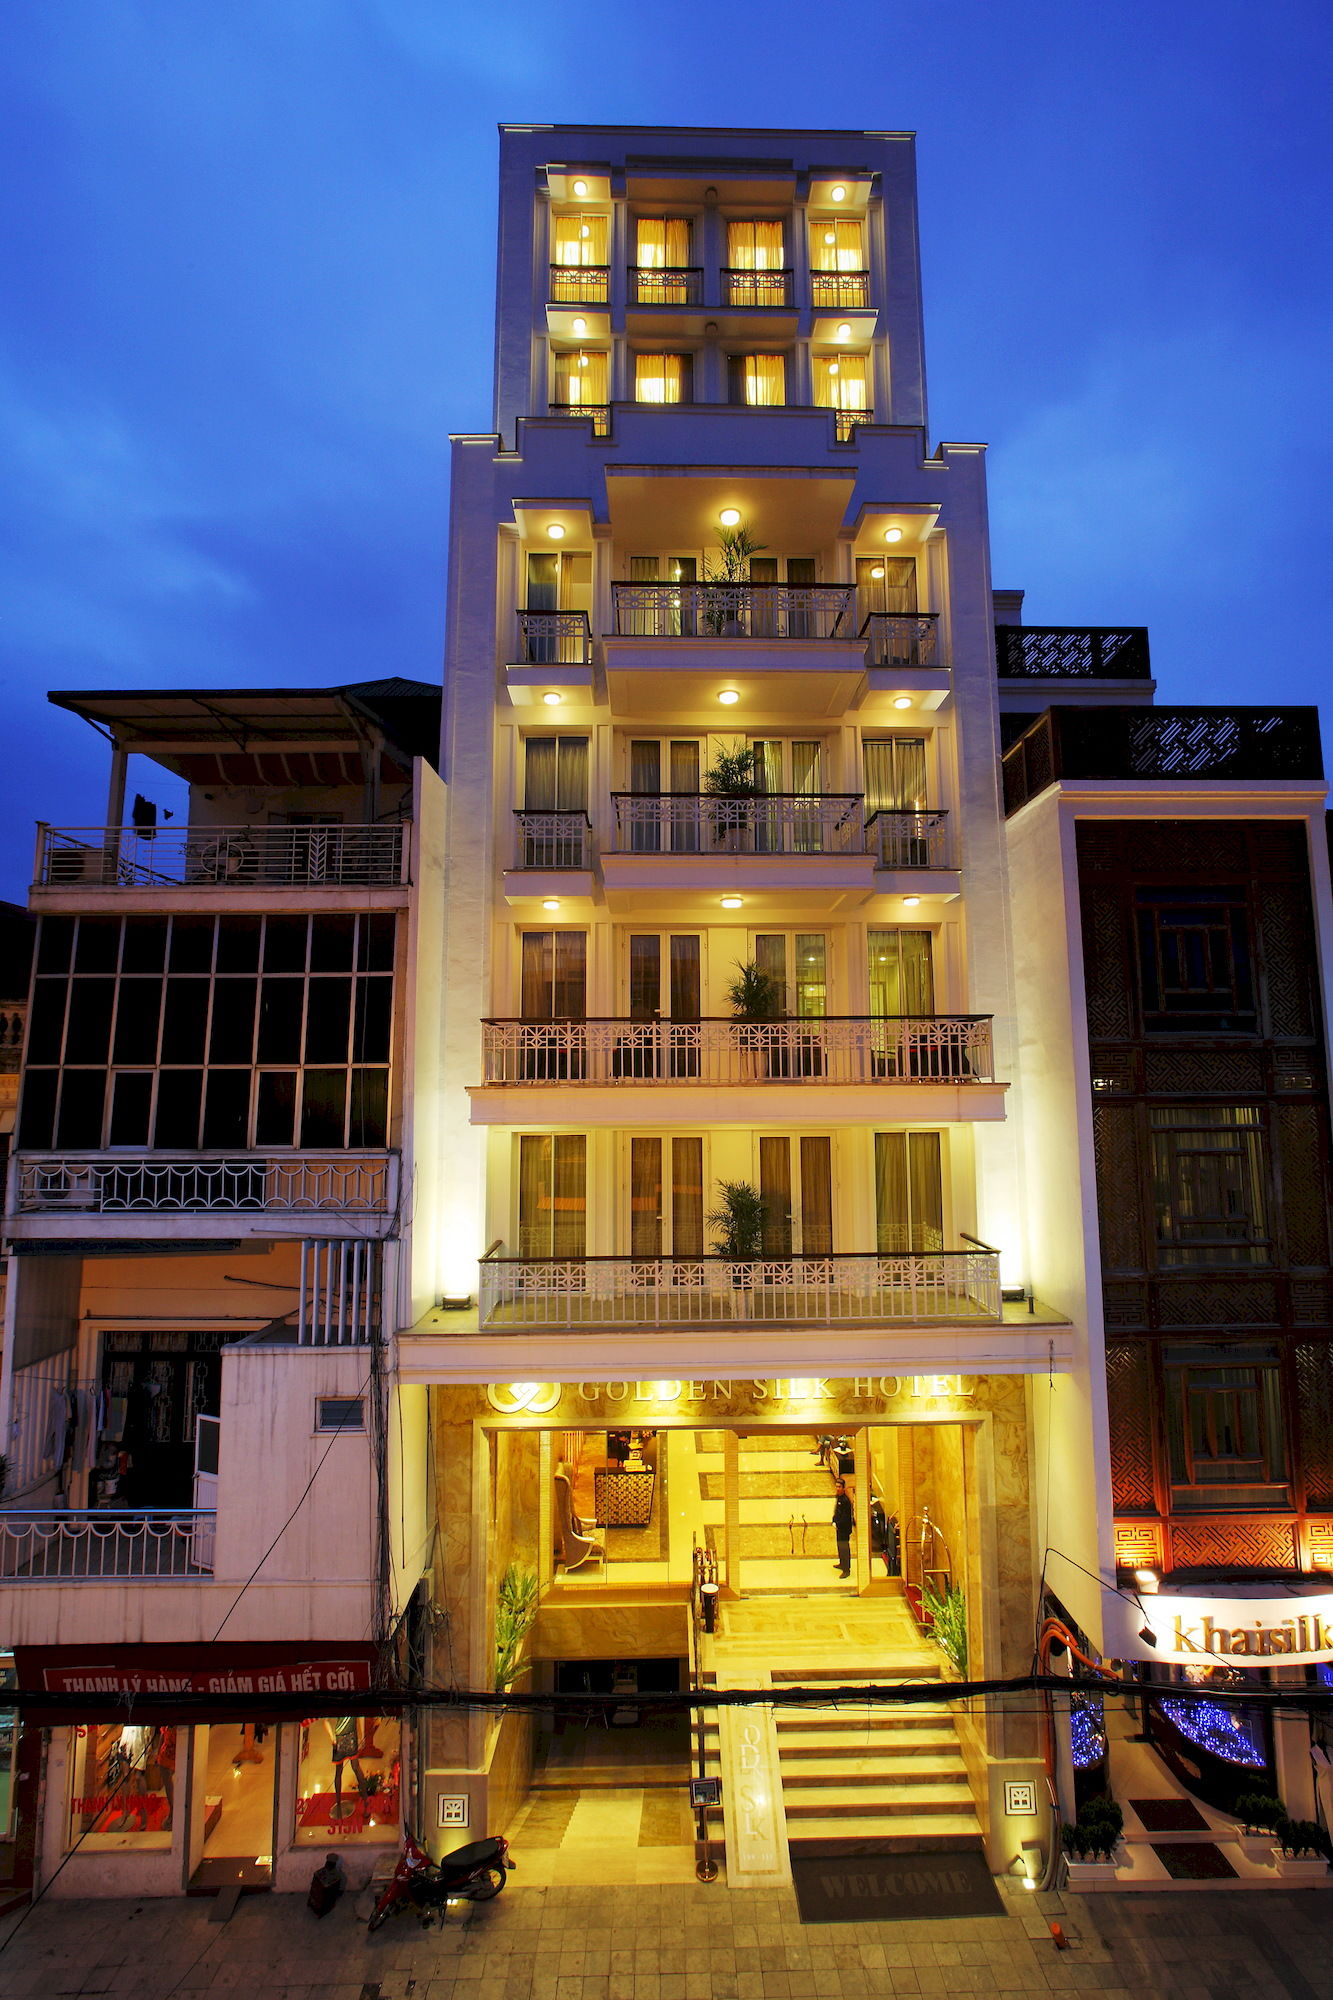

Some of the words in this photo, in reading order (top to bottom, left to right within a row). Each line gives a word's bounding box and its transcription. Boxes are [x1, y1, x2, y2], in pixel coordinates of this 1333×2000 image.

[578, 1379, 733, 1401] GOLDEN
[752, 1377, 836, 1400] SILK
[852, 1374, 975, 1398] HOTEL
[1172, 1613, 1333, 1656] khaisilk
[63, 1677, 119, 1693] THANH
[258, 1671, 287, 1693] GIÁ
[291, 1666, 322, 1691] HẾT
[821, 1871, 972, 1899] WELCOME
